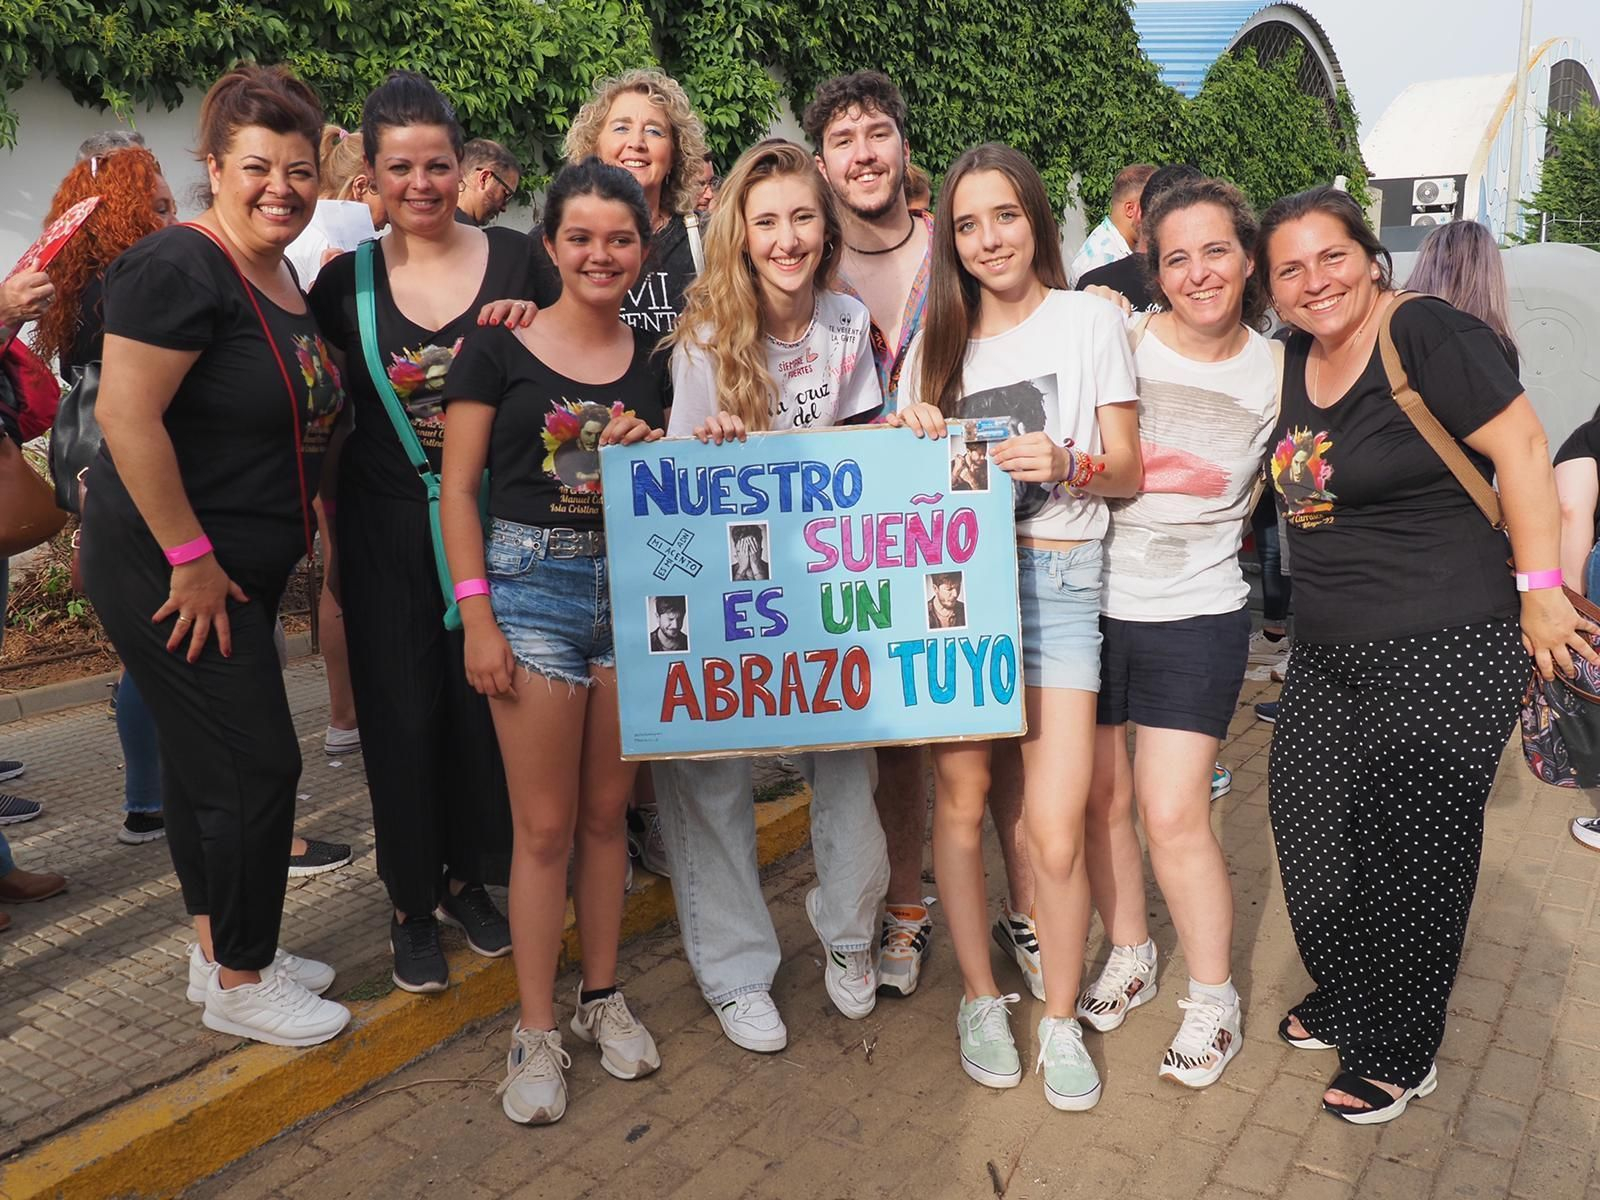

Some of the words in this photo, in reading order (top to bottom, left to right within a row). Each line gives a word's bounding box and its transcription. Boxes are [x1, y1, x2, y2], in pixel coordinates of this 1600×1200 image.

[793, 402, 821, 427] del
[795, 383, 830, 405] cruz
[631, 457, 862, 517] NUESTRO
[651, 538, 663, 550] MI
[664, 546, 697, 571] ACENTO
[803, 492, 979, 574] SUEÑO
[723, 587, 788, 642] ES
[820, 579, 891, 634] UN
[660, 646, 871, 722] ABRAZO
[888, 635, 1016, 708] TUYO
